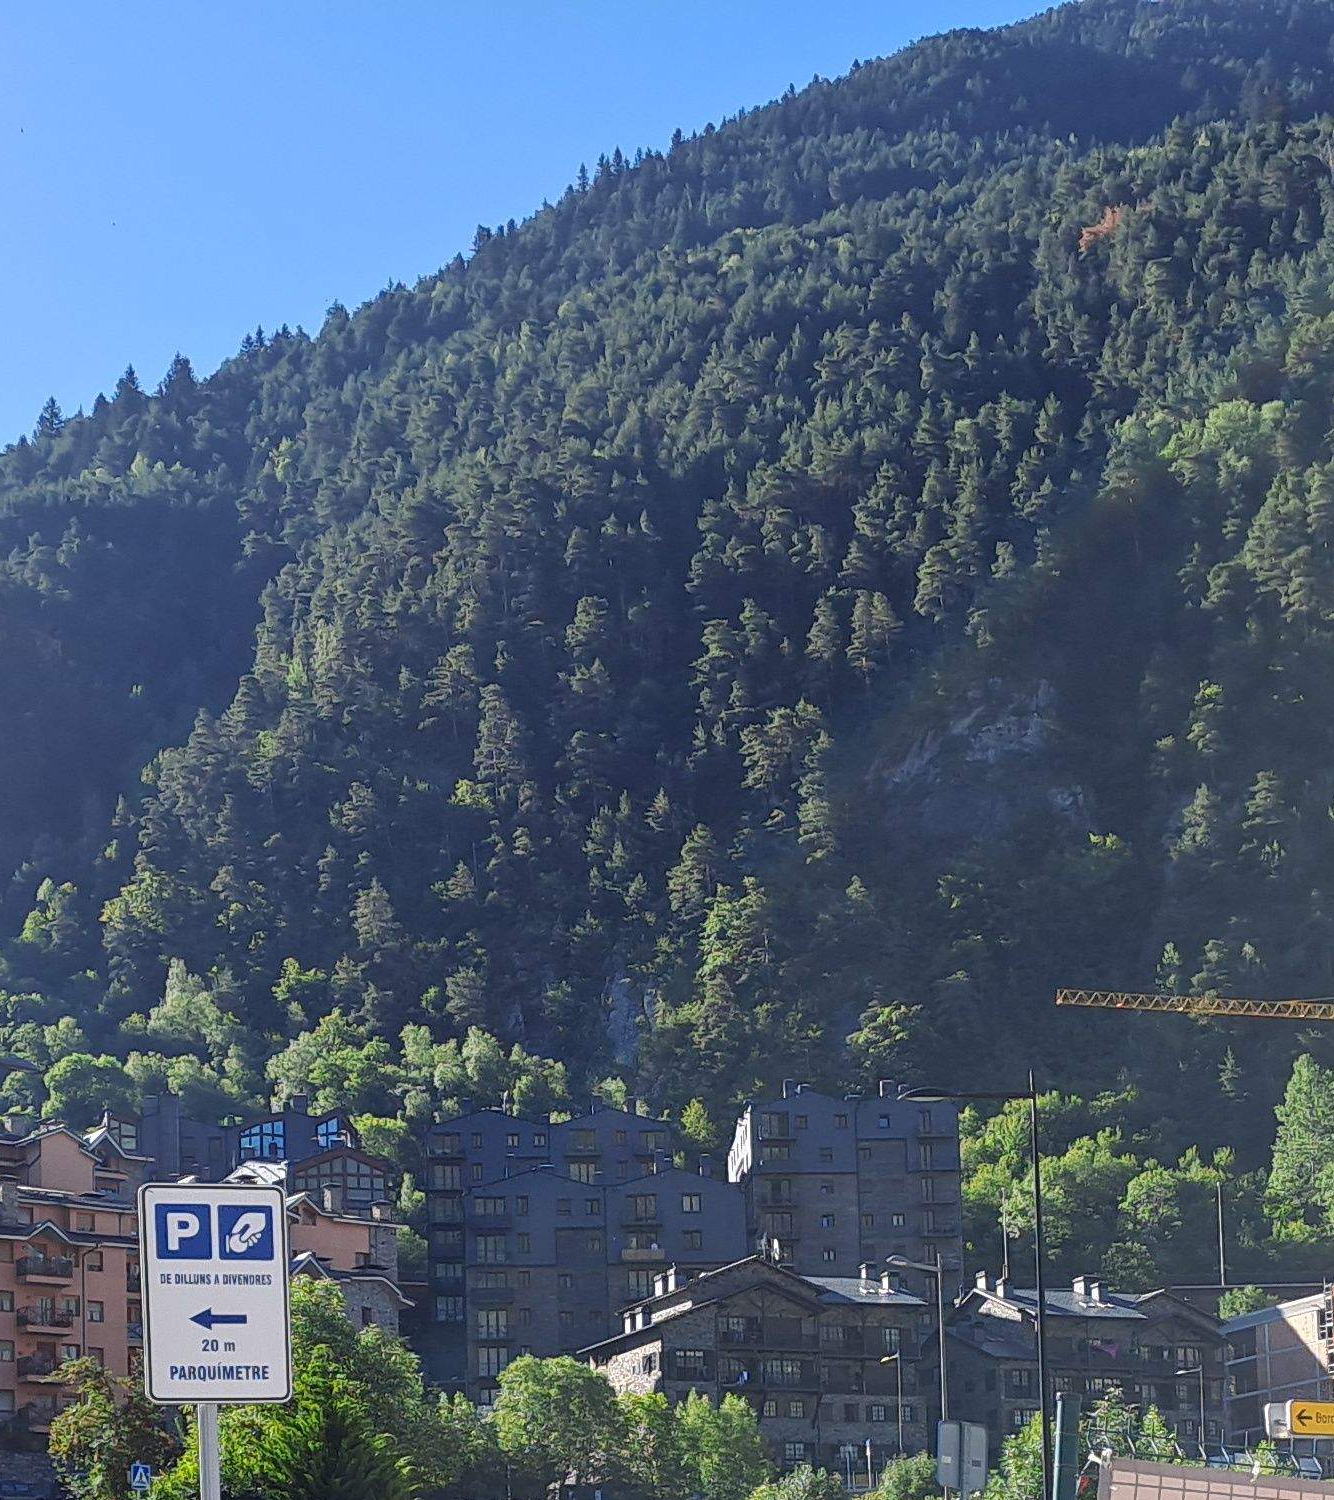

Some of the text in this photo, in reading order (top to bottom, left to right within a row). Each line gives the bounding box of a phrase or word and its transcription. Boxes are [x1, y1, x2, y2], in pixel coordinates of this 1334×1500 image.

[167, 1212, 200, 1251] P
[160, 1274, 272, 1286] DE DILLUNS A DIVENDRES
[201, 1339, 236, 1353] 20 m
[169, 1363, 270, 1381] PARQUÍMETRE
